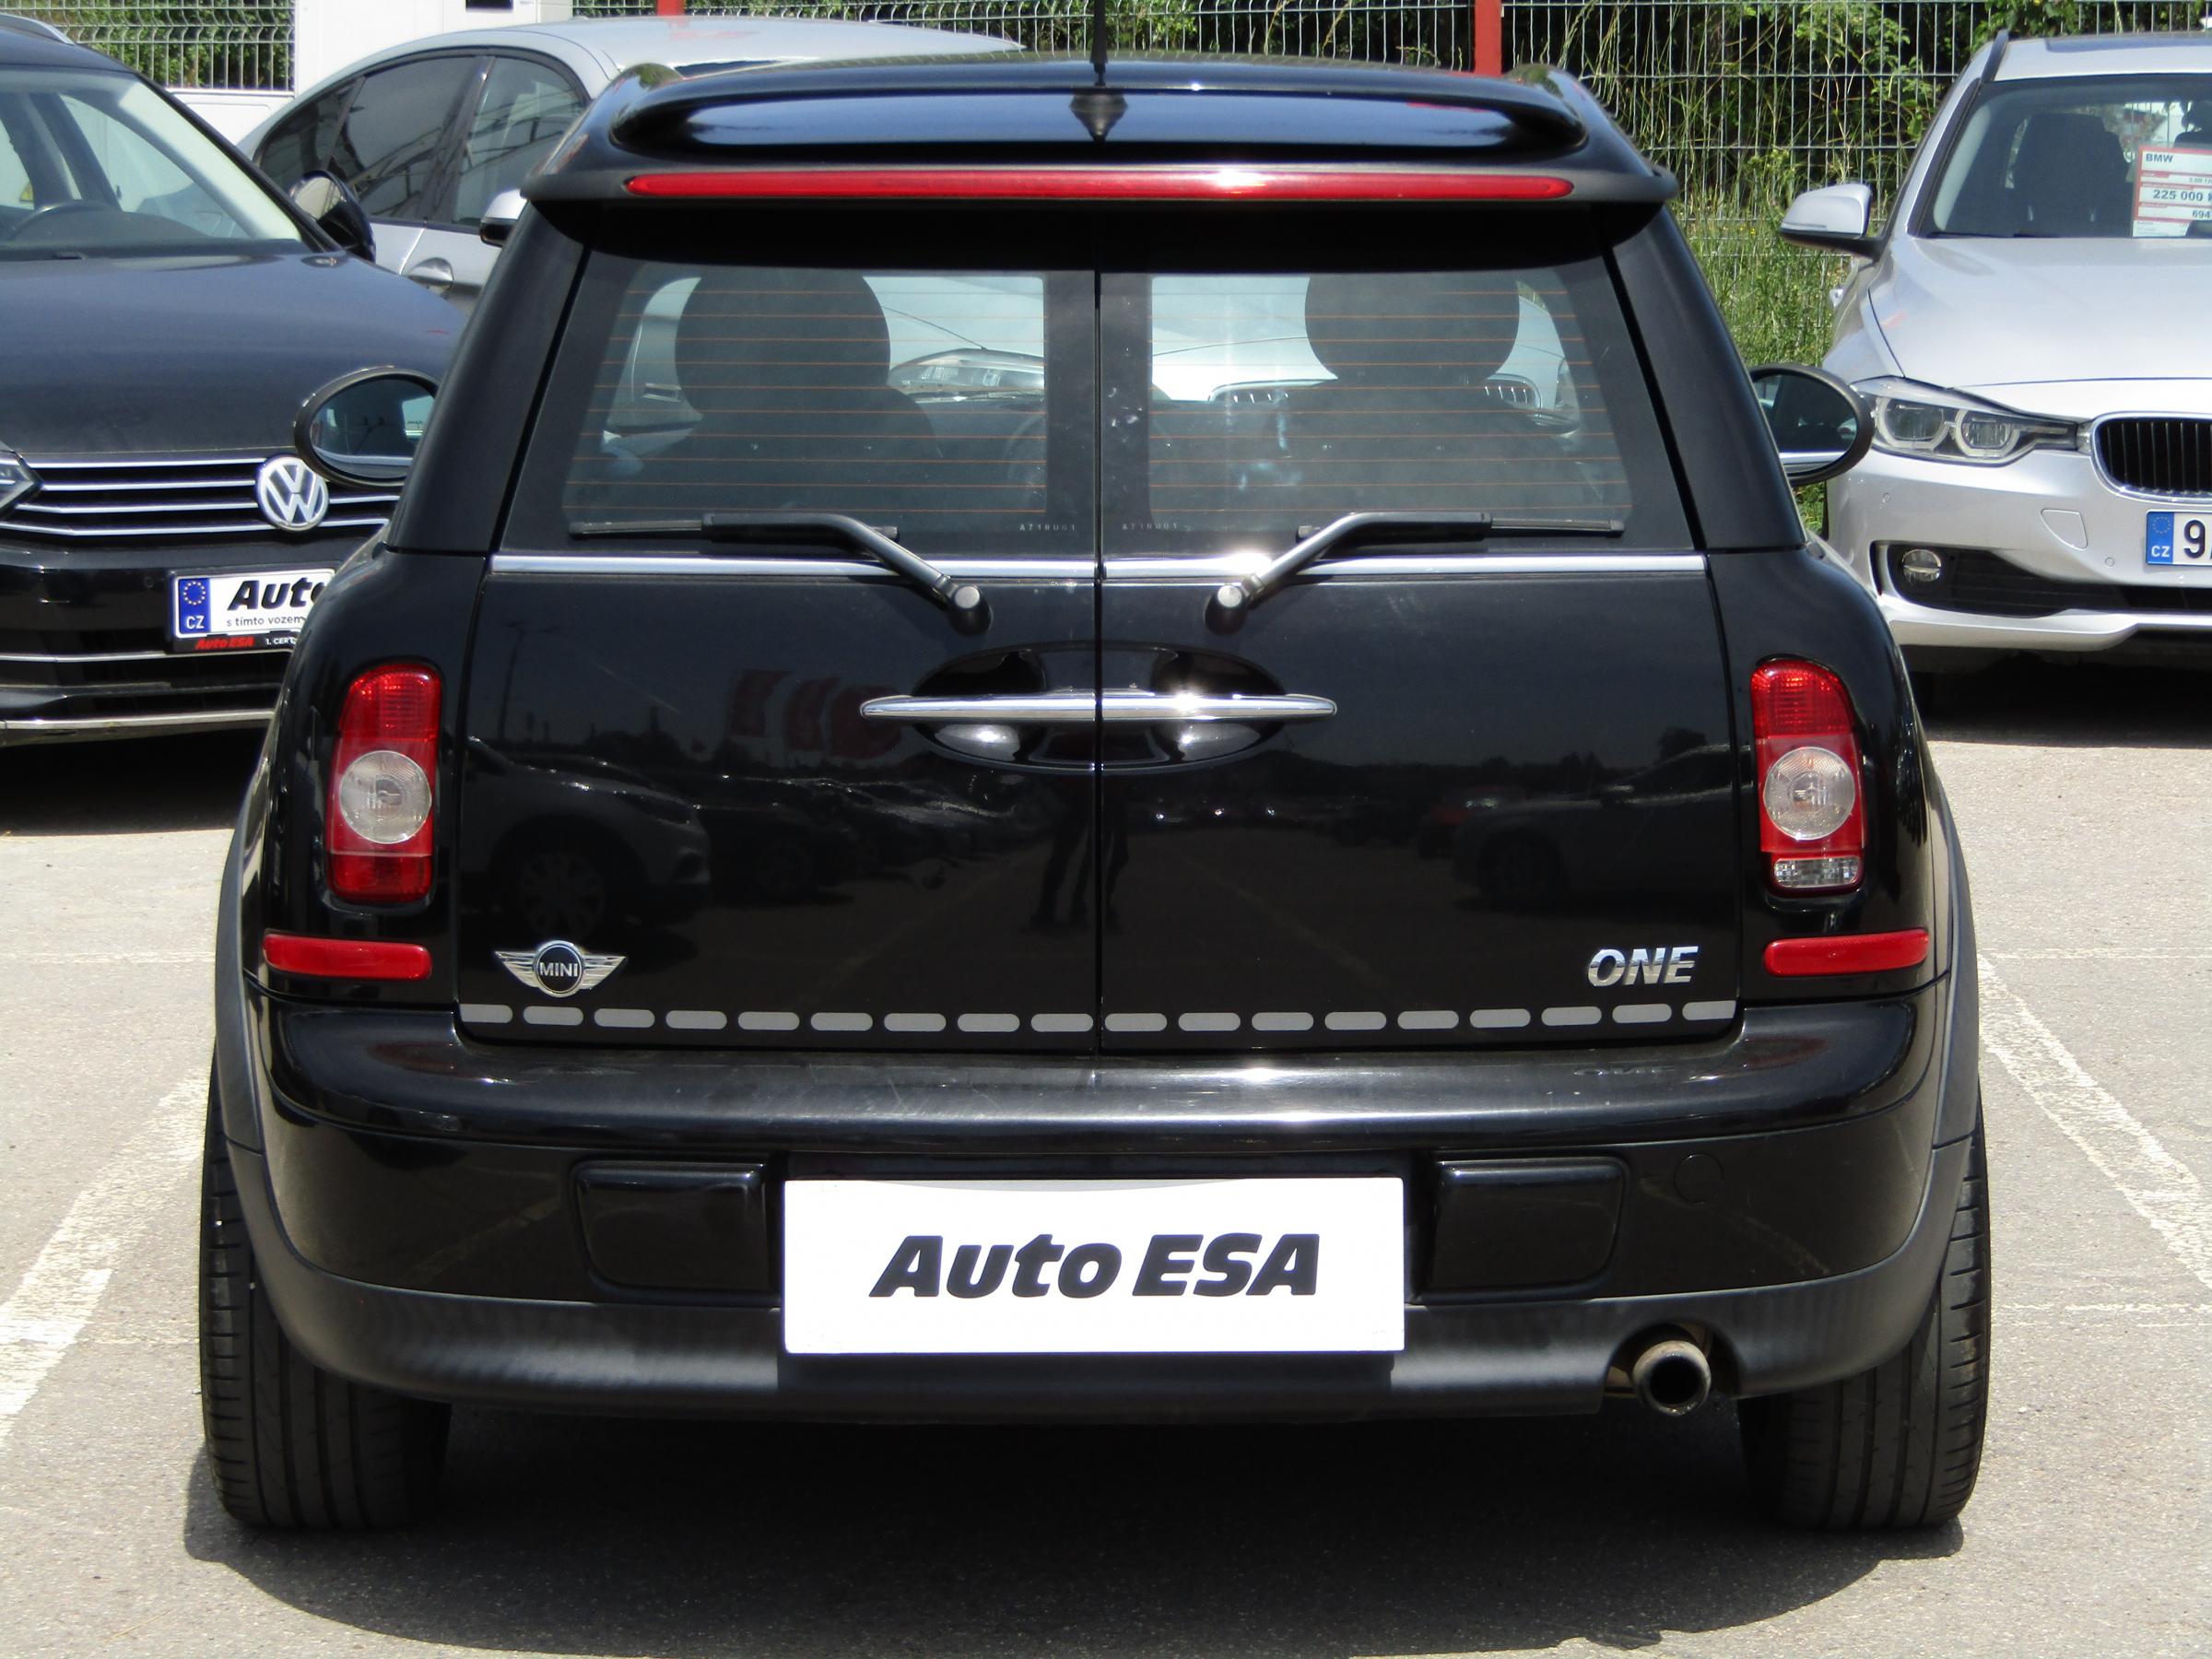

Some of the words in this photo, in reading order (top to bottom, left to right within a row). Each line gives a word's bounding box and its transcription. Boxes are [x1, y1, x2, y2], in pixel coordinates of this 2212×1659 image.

[2146, 153, 2173, 163] BMW
[2152, 189, 2176, 200] 225
[2180, 191, 2204, 202] 000
[2192, 209, 2211, 218] 694
[2183, 519, 2212, 559] 9
[2151, 545, 2171, 558] CZ
[186, 615, 205, 629] CZ
[539, 962, 579, 978] MINI
[1587, 946, 1699, 987] ONE
[868, 1233, 1123, 1299] Auto
[1131, 1232, 1320, 1297] ESA
